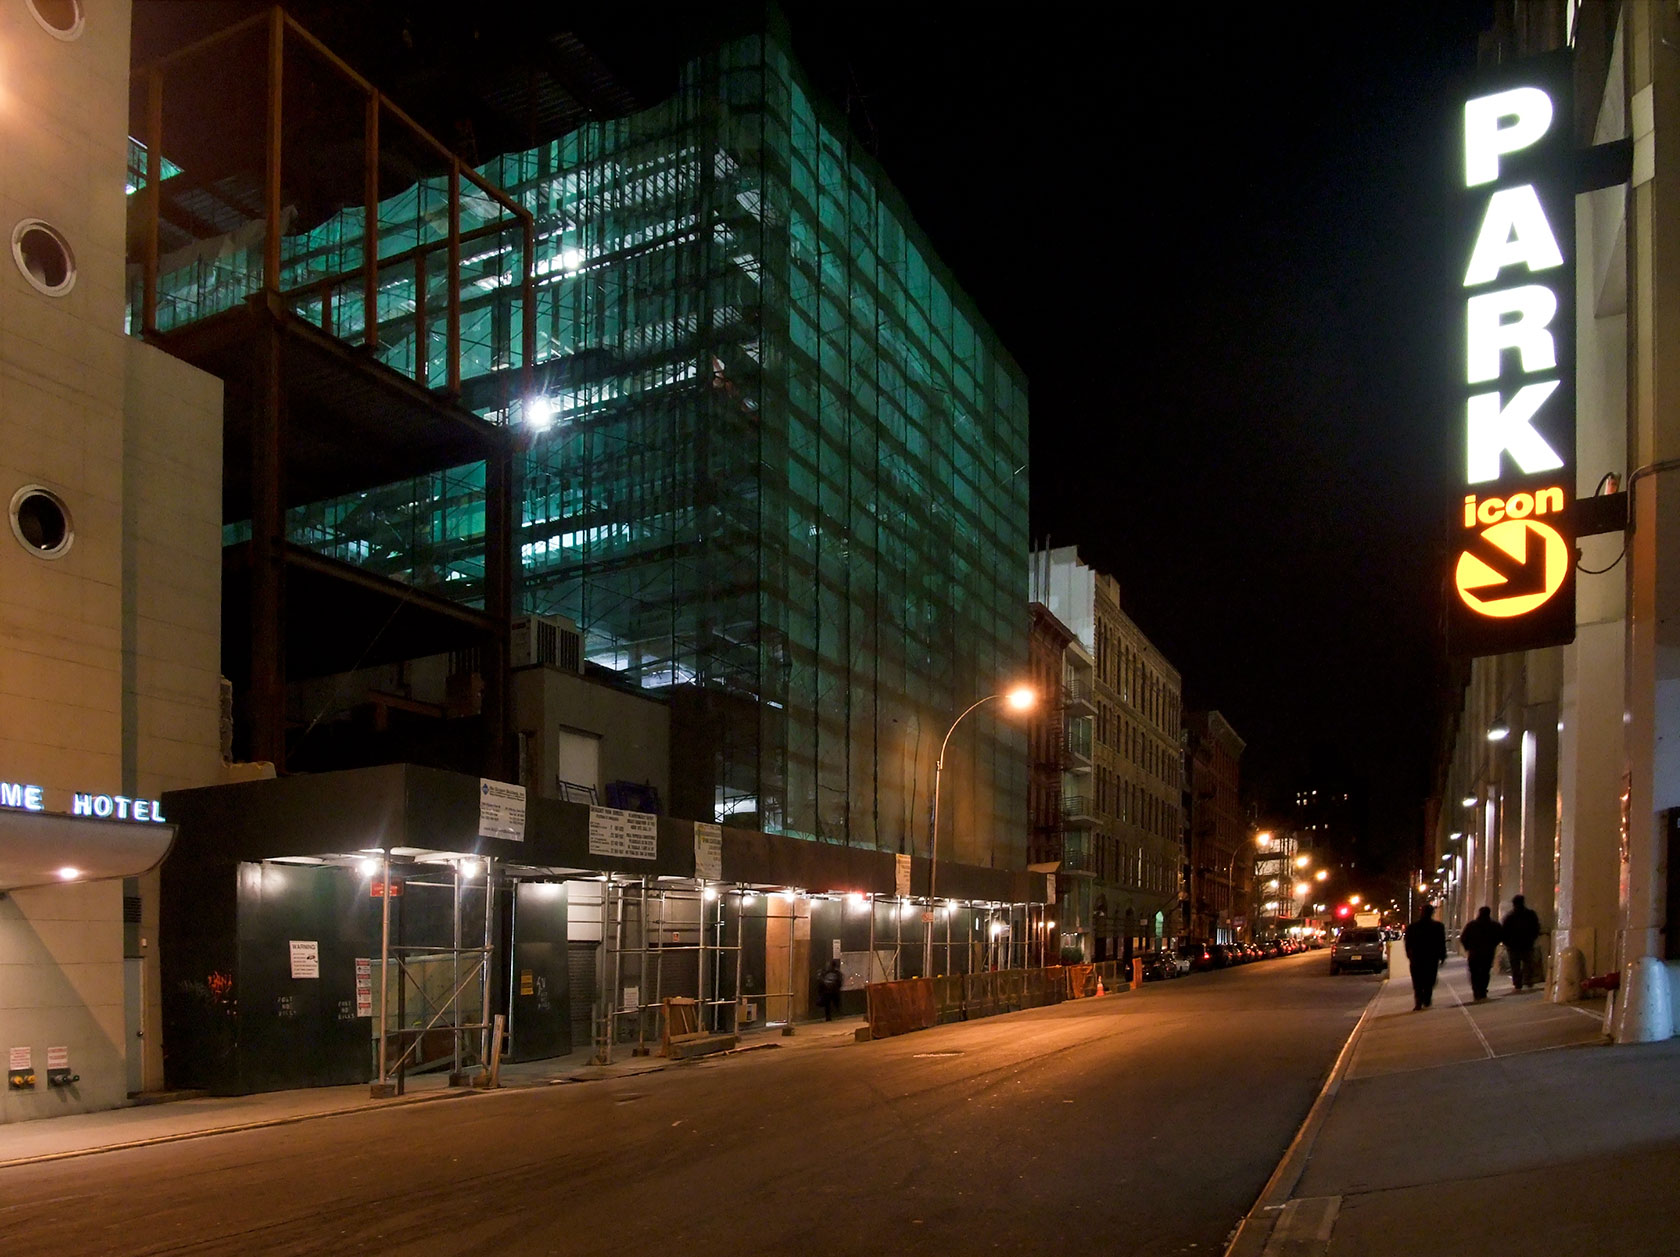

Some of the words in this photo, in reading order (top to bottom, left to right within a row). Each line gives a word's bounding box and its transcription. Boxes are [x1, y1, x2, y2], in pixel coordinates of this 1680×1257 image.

[1463, 87, 1564, 484] PARK
[1464, 487, 1564, 528] icon
[73, 793, 166, 823] HOTEL
